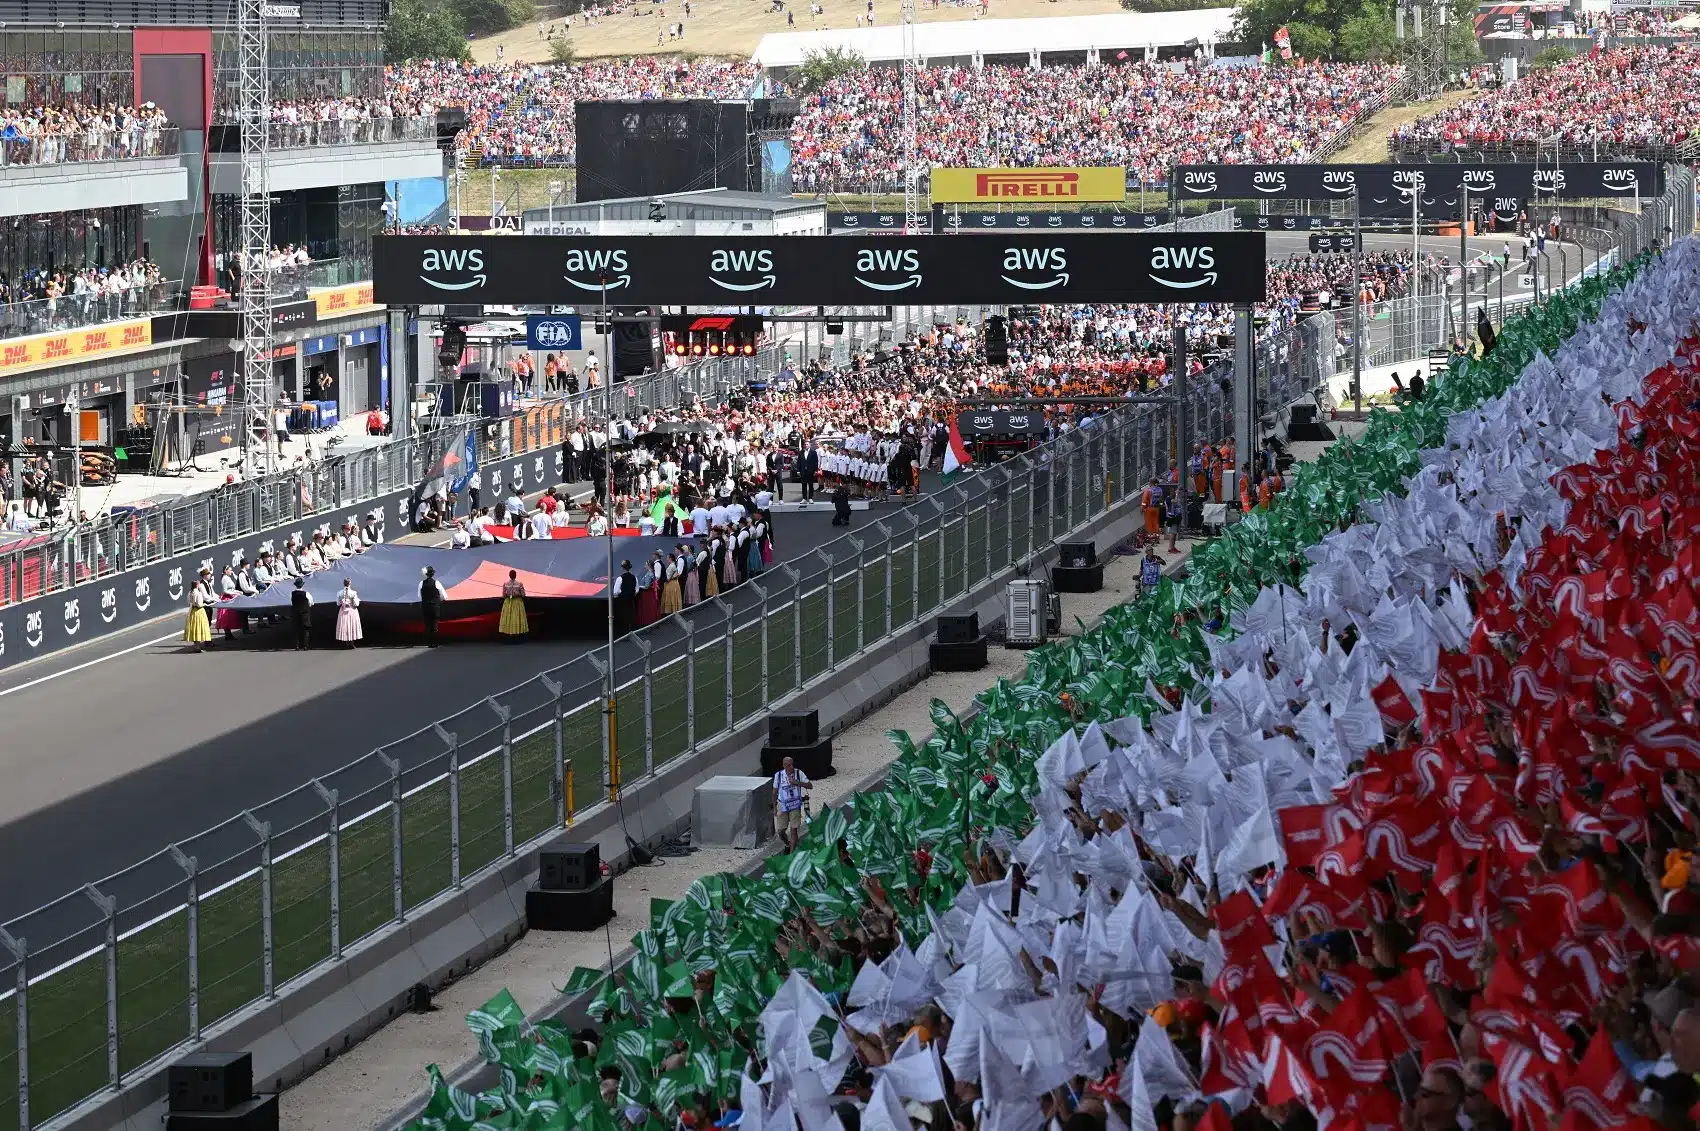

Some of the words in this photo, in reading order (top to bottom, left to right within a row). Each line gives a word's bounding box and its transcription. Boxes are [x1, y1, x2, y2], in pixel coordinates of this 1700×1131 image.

[976, 173, 1080, 197] PIRELLI
[1184, 171, 1216, 184] aws
[1253, 171, 1286, 184] aws
[1322, 171, 1355, 184] aws
[1463, 170, 1494, 182] aws
[1533, 169, 1565, 182] aws
[1603, 169, 1635, 181] aws
[1495, 197, 1517, 211] aws
[533, 227, 591, 235] MEDICAL
[422, 248, 484, 273] aws
[566, 248, 629, 273] aws
[710, 249, 774, 273] aws
[856, 248, 919, 272] aws
[1003, 247, 1066, 271] aws
[1151, 246, 1214, 270] aws
[85, 332, 108, 352] DHL
[124, 326, 145, 345] DHL
[4, 345, 28, 366] DHL
[45, 338, 69, 359] DHL
[973, 416, 993, 424] aws
[1009, 415, 1029, 424] aws
[135, 576, 150, 597] aws
[169, 566, 183, 587] aws
[101, 587, 116, 609] aws
[64, 598, 79, 621] aws
[26, 610, 42, 632] aws
